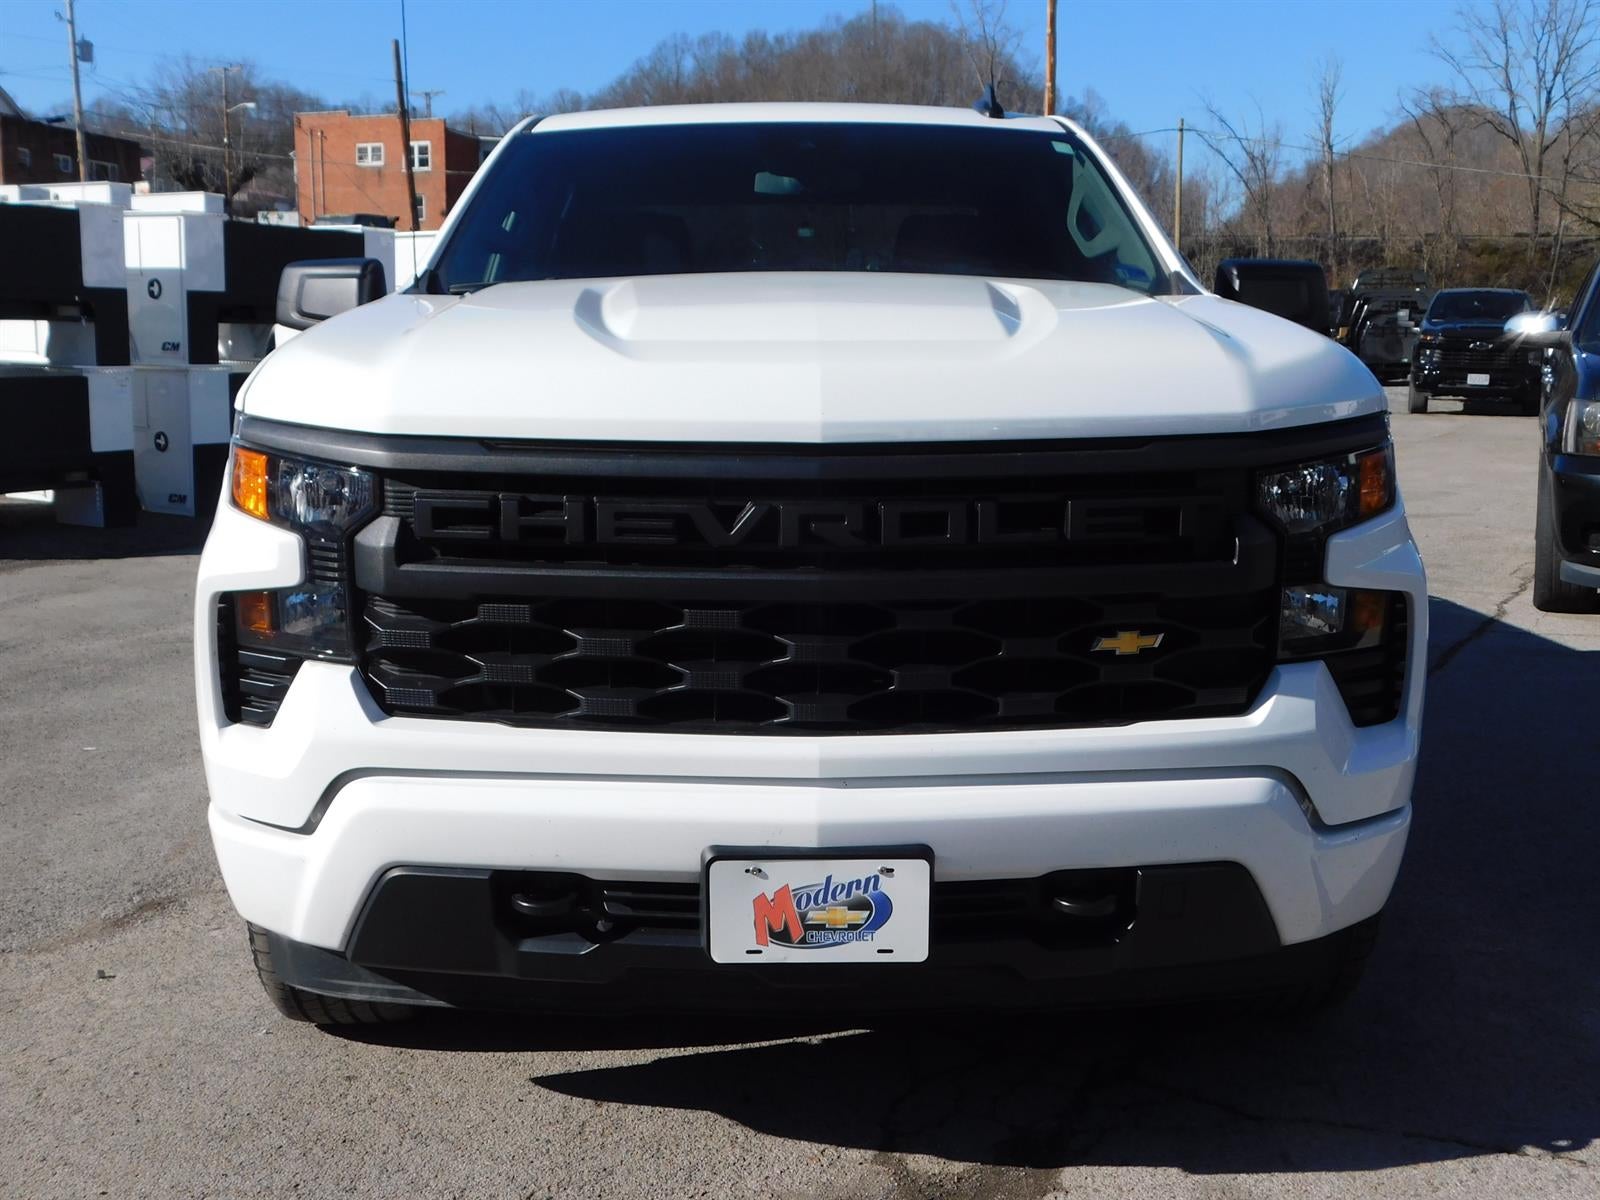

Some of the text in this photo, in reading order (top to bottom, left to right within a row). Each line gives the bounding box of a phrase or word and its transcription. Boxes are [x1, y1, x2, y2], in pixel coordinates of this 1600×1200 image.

[161, 341, 181, 352] CM
[167, 493, 187, 504] CM
[413, 491, 1222, 547] CHEVROLET
[752, 874, 881, 947] Modern
[806, 931, 876, 942] CHEVROLET
